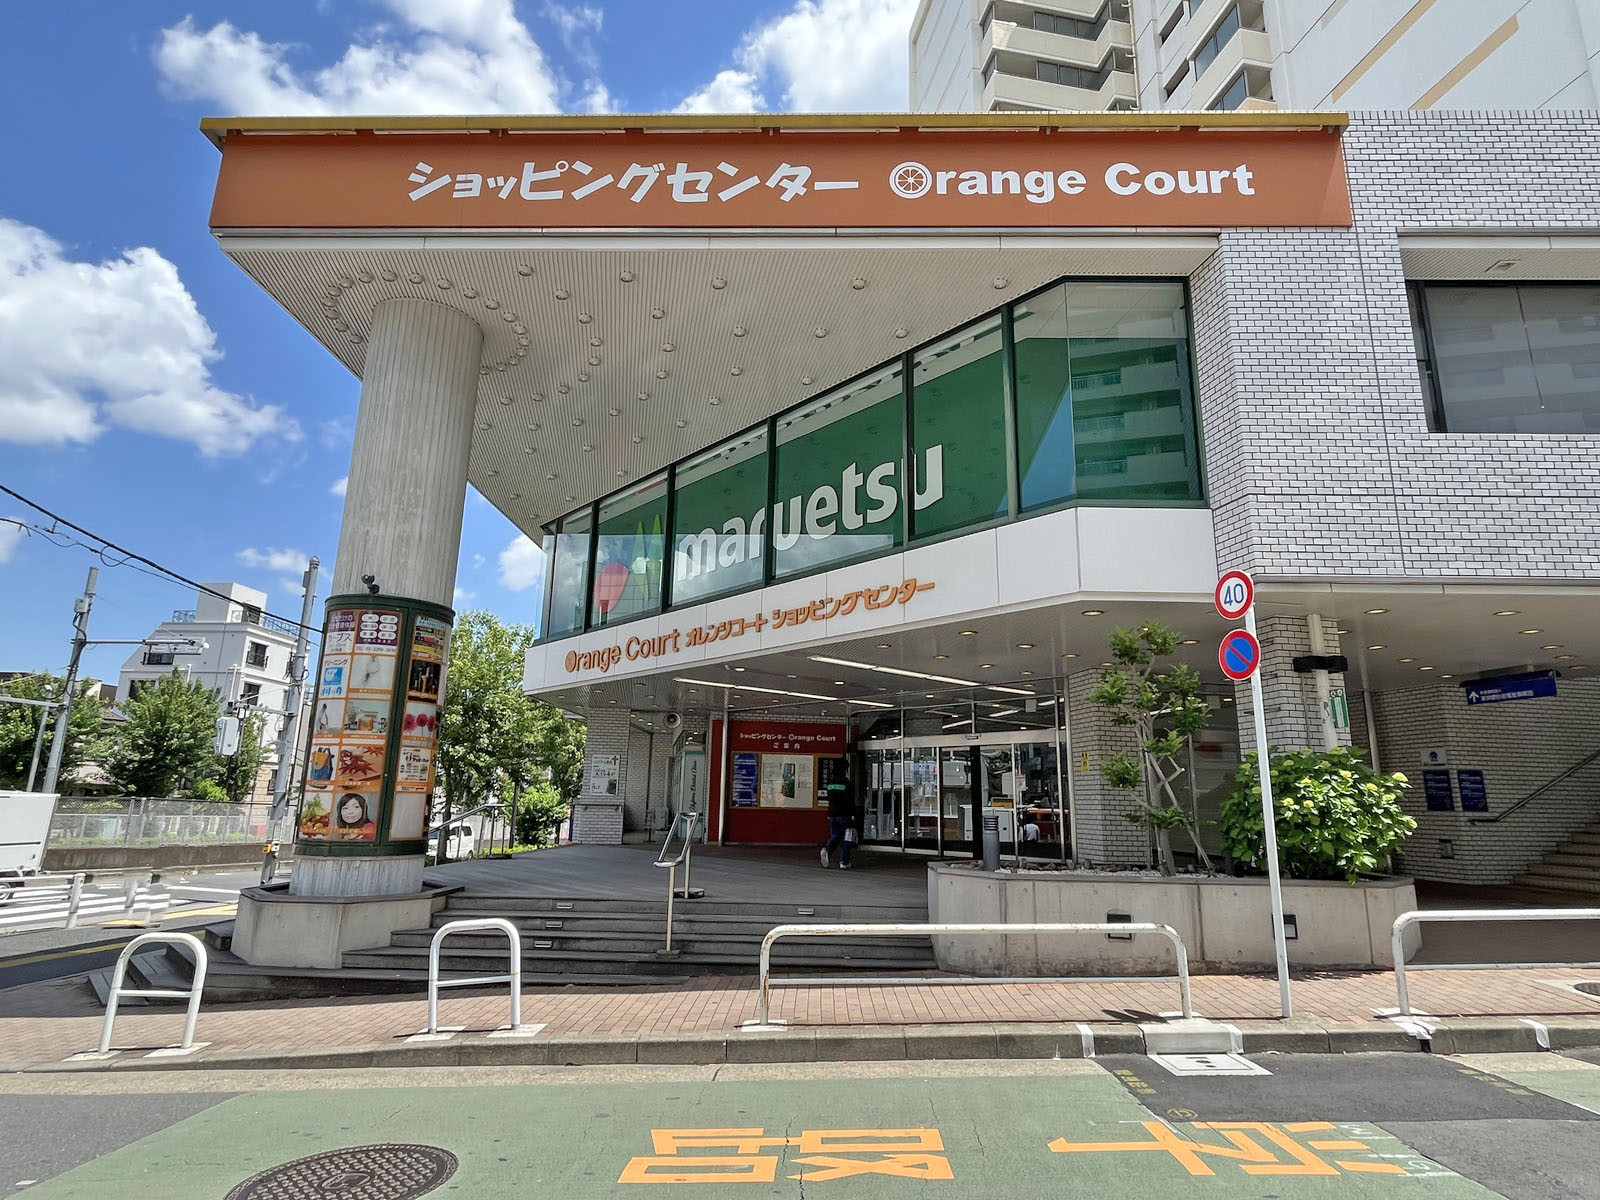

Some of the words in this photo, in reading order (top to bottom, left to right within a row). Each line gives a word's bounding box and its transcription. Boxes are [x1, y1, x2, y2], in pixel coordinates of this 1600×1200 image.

[408, 160, 859, 203] ショッピングセンター
[889, 161, 1087, 204] Orange
[1104, 162, 1255, 196] Court
[677, 444, 943, 582] maruetsu
[565, 645, 621, 673] Orange
[625, 628, 681, 660] Court
[685, 613, 768, 648] オレンジコート
[772, 577, 935, 630] ショッピングセンター
[1223, 583, 1245, 606] 40
